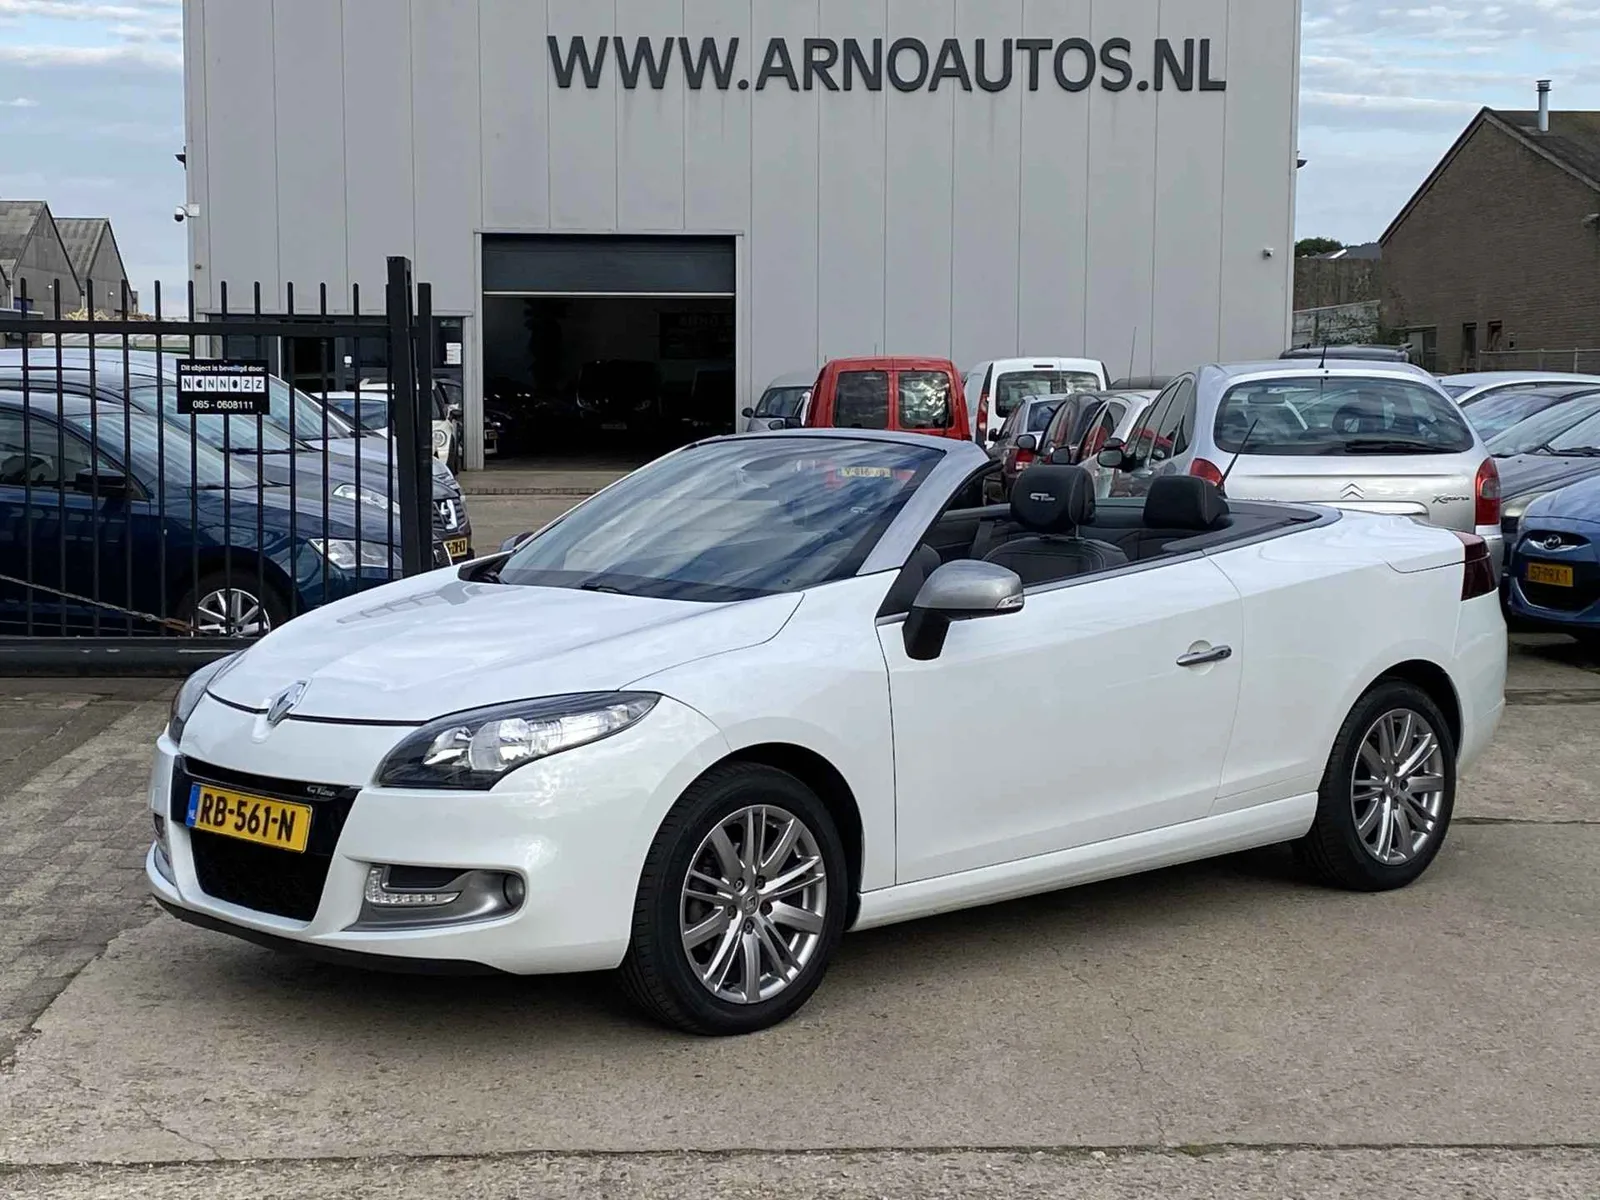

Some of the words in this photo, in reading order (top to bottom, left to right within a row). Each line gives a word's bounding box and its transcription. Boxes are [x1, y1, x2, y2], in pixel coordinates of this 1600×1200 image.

[547, 36, 1227, 93] WWW.ARNOAUTOS.NL
[191, 365, 211, 373] object
[193, 400, 209, 409] 085
[200, 793, 296, 841] RB-561-N
